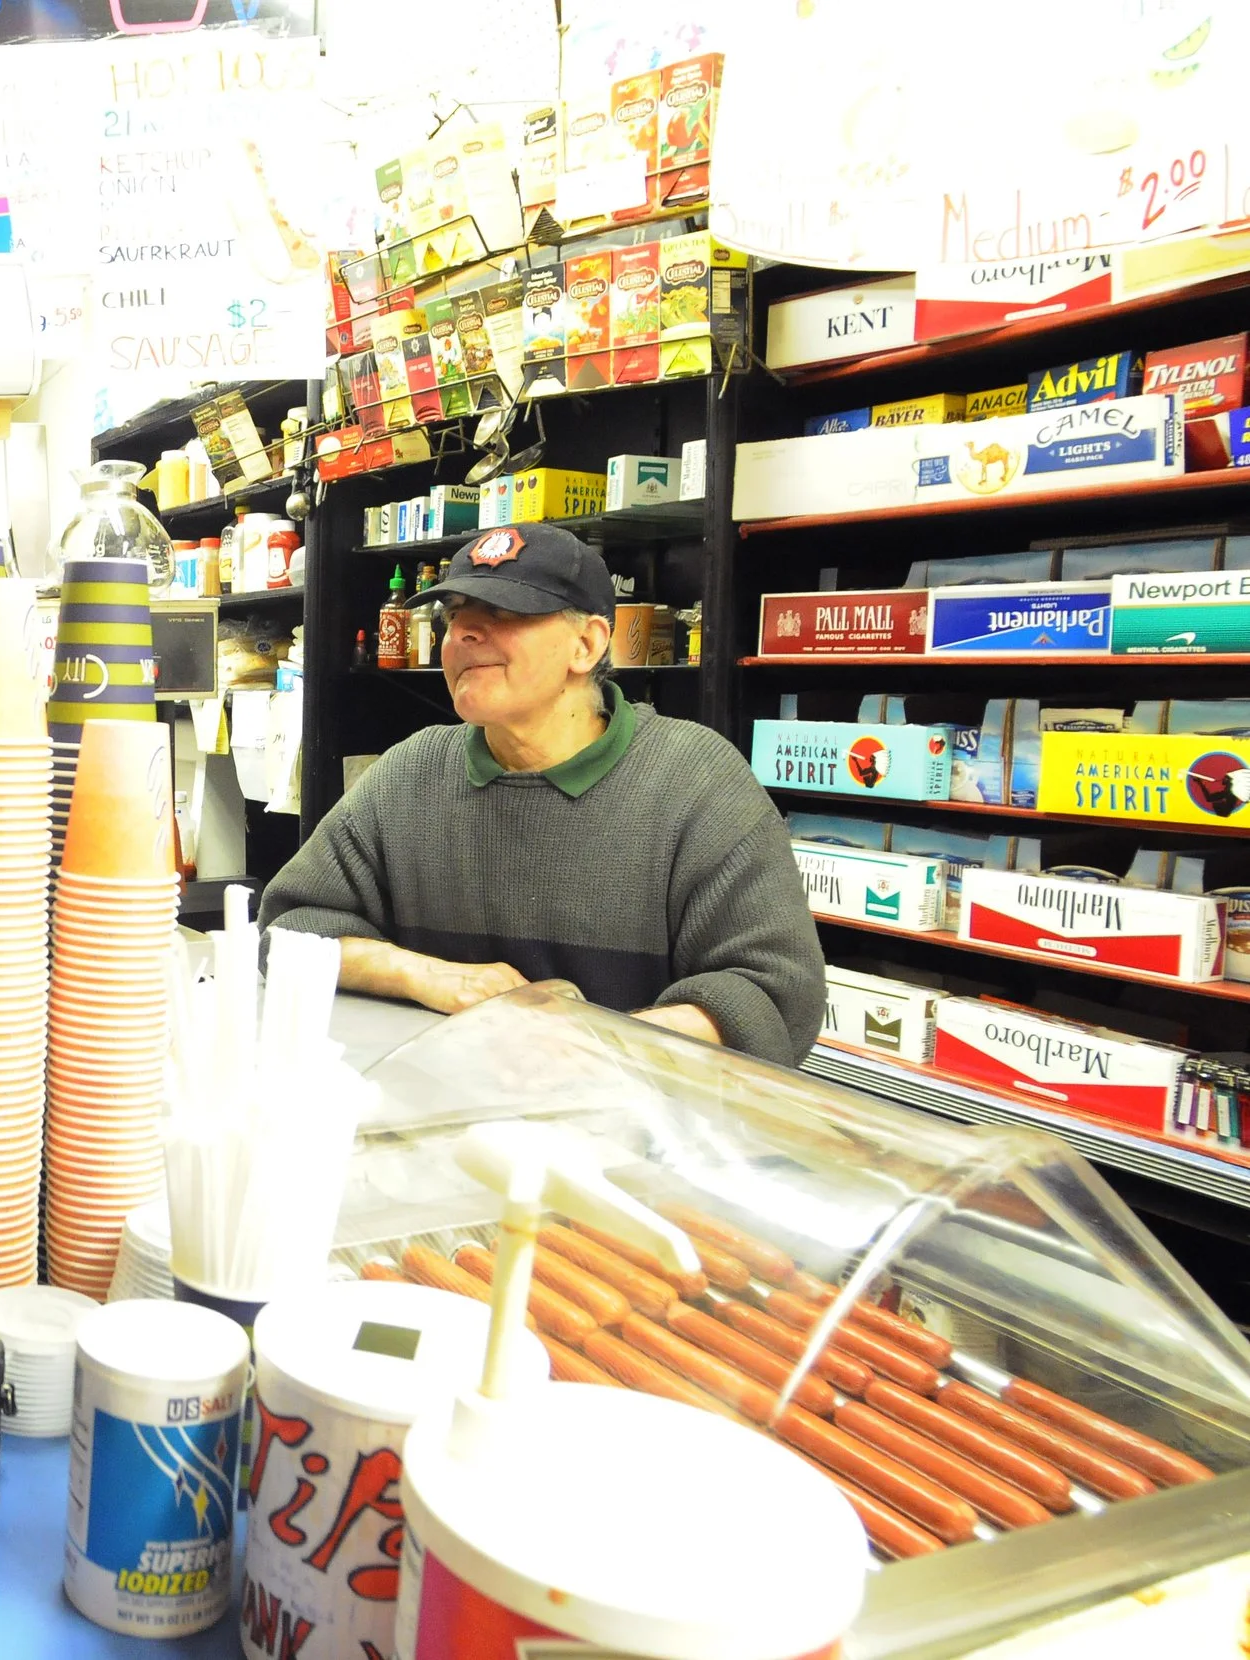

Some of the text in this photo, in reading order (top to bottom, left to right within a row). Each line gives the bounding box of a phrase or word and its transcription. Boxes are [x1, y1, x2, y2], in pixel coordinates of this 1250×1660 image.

[99, 148, 212, 174] KETCHUP
[99, 175, 177, 196] ONION
[102, 287, 165, 309] CHILI
[827, 306, 894, 339] KENT
[110, 329, 275, 371] SAUSAGE
[1031, 353, 1122, 403] Advil
[1148, 354, 1237, 389] TYLENOL
[1178, 379, 1215, 394] EXTRA
[875, 408, 925, 427] BAYER
[1036, 407, 1139, 444] CAMEL
[1059, 441, 1111, 457] LIGHTS
[1128, 579, 1231, 601] Newport
[815, 605, 894, 631] PALL MALL
[988, 606, 1104, 637] Parliament
[815, 632, 892, 641] FAMOUS CIGARETTES
[776, 744, 838, 759] AMERICAN
[777, 733, 838, 745] NATURAL
[1076, 749, 1170, 764] NATURAL
[776, 761, 838, 786] SPIRIT
[1076, 763, 1171, 781] AMERICAN
[1075, 781, 1170, 814] SPIRIT
[1017, 883, 1125, 931] Marlboro
[984, 1023, 1113, 1080] Marlboro
[117, 1569, 209, 1596] IODIZED
